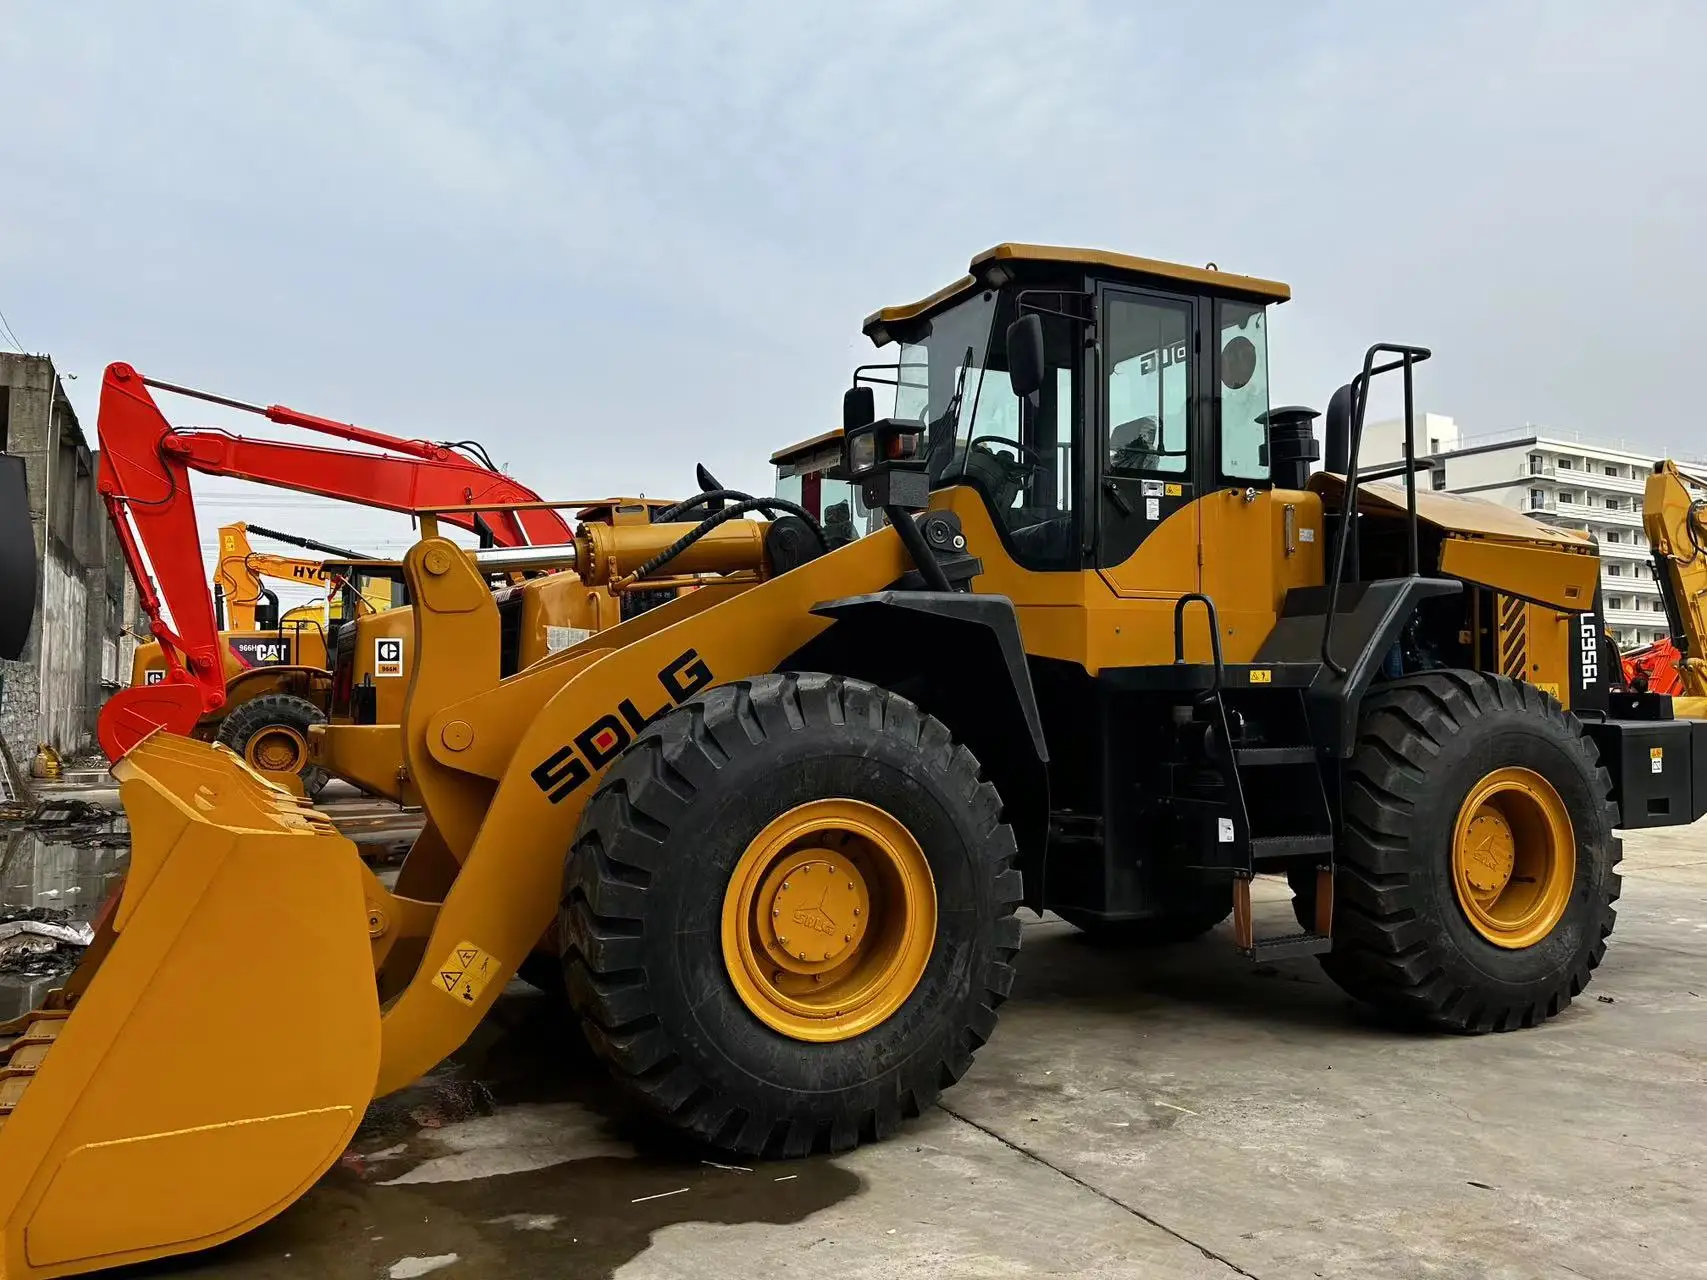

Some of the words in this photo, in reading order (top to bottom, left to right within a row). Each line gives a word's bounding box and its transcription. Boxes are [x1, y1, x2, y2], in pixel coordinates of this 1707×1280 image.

[239, 644, 257, 652] 966H
[256, 644, 287, 661] CAT
[1580, 612, 1598, 690] LG956L
[530, 647, 714, 805] SDLG
